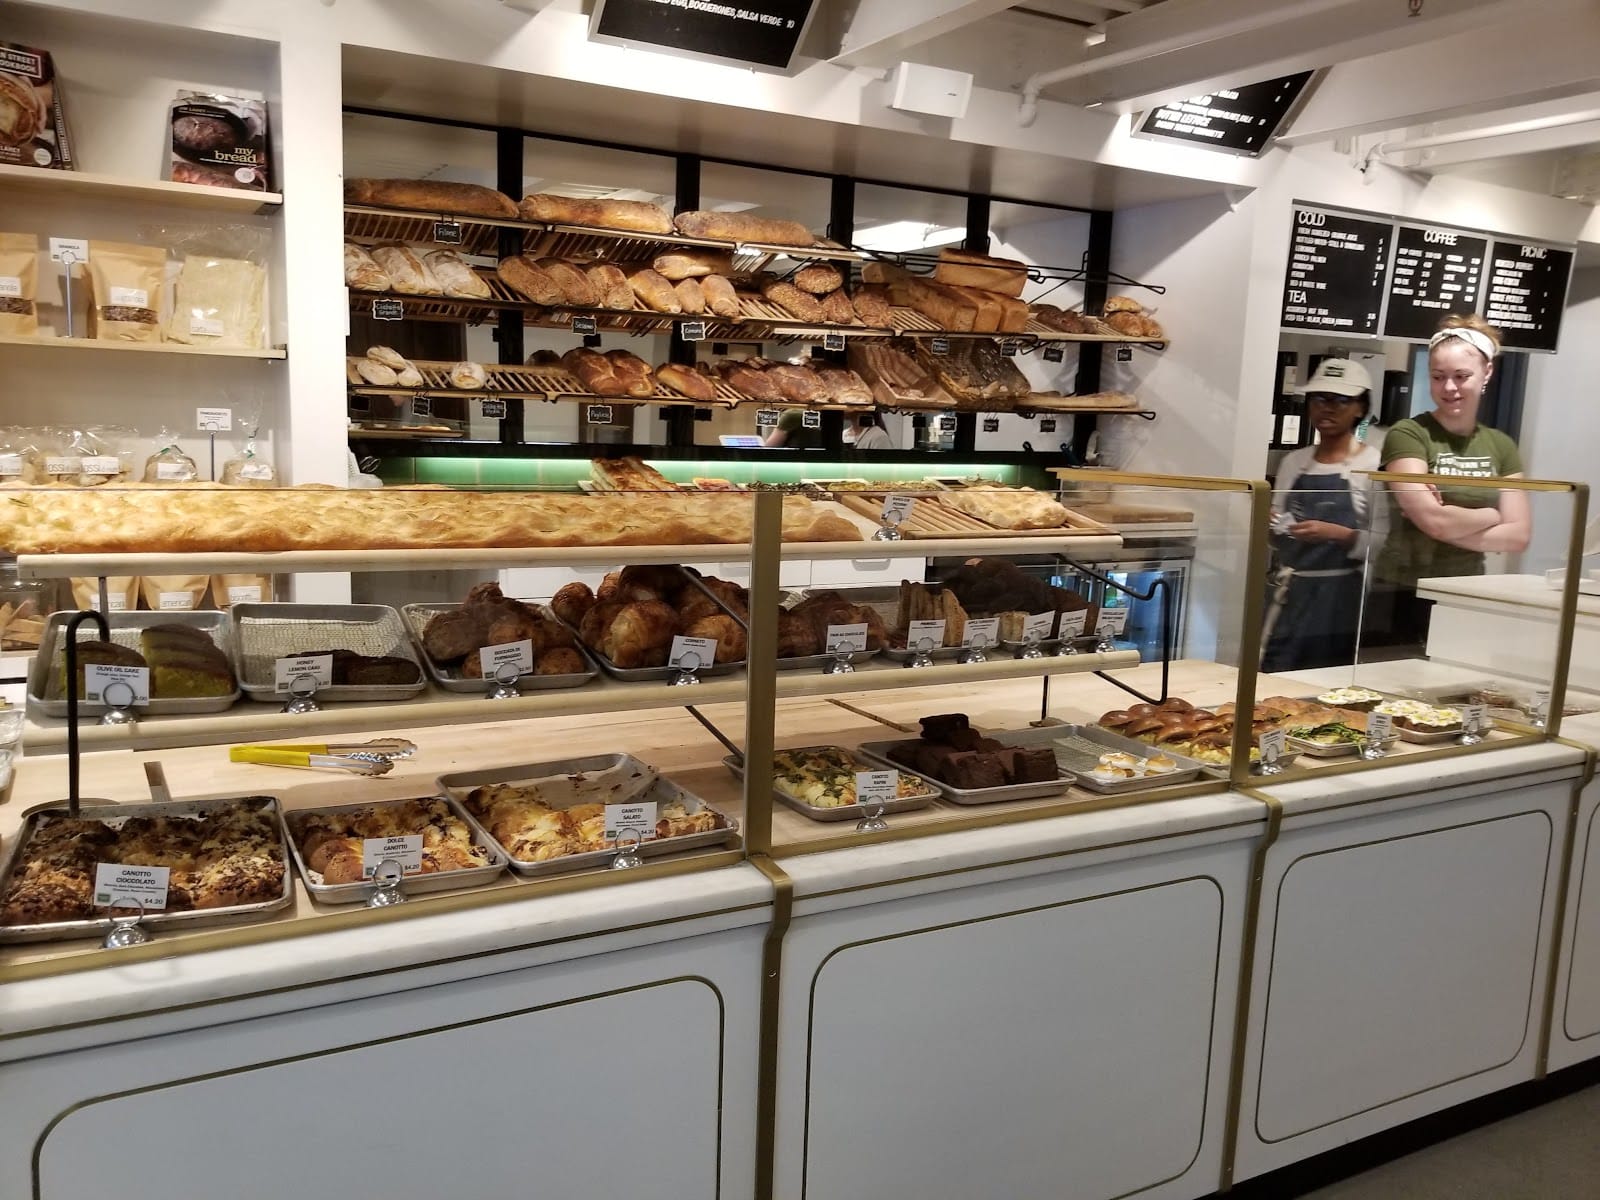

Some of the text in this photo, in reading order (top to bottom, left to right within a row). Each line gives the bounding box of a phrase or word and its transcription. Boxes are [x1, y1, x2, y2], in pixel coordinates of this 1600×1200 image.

[759, 14, 783, 26] VERDE
[8, 53, 36, 66] STREET
[0, 60, 38, 74] OOKBOOK
[214, 150, 257, 163] bread
[235, 147, 254, 156] my
[1298, 211, 1326, 227] COLD
[1423, 230, 1458, 246] COFFEE
[1520, 246, 1548, 260] PICNIC
[1288, 289, 1307, 304] TEA
[121, 870, 152, 878] CANOTTO
[115, 877, 156, 886] CIOCCOLATO
